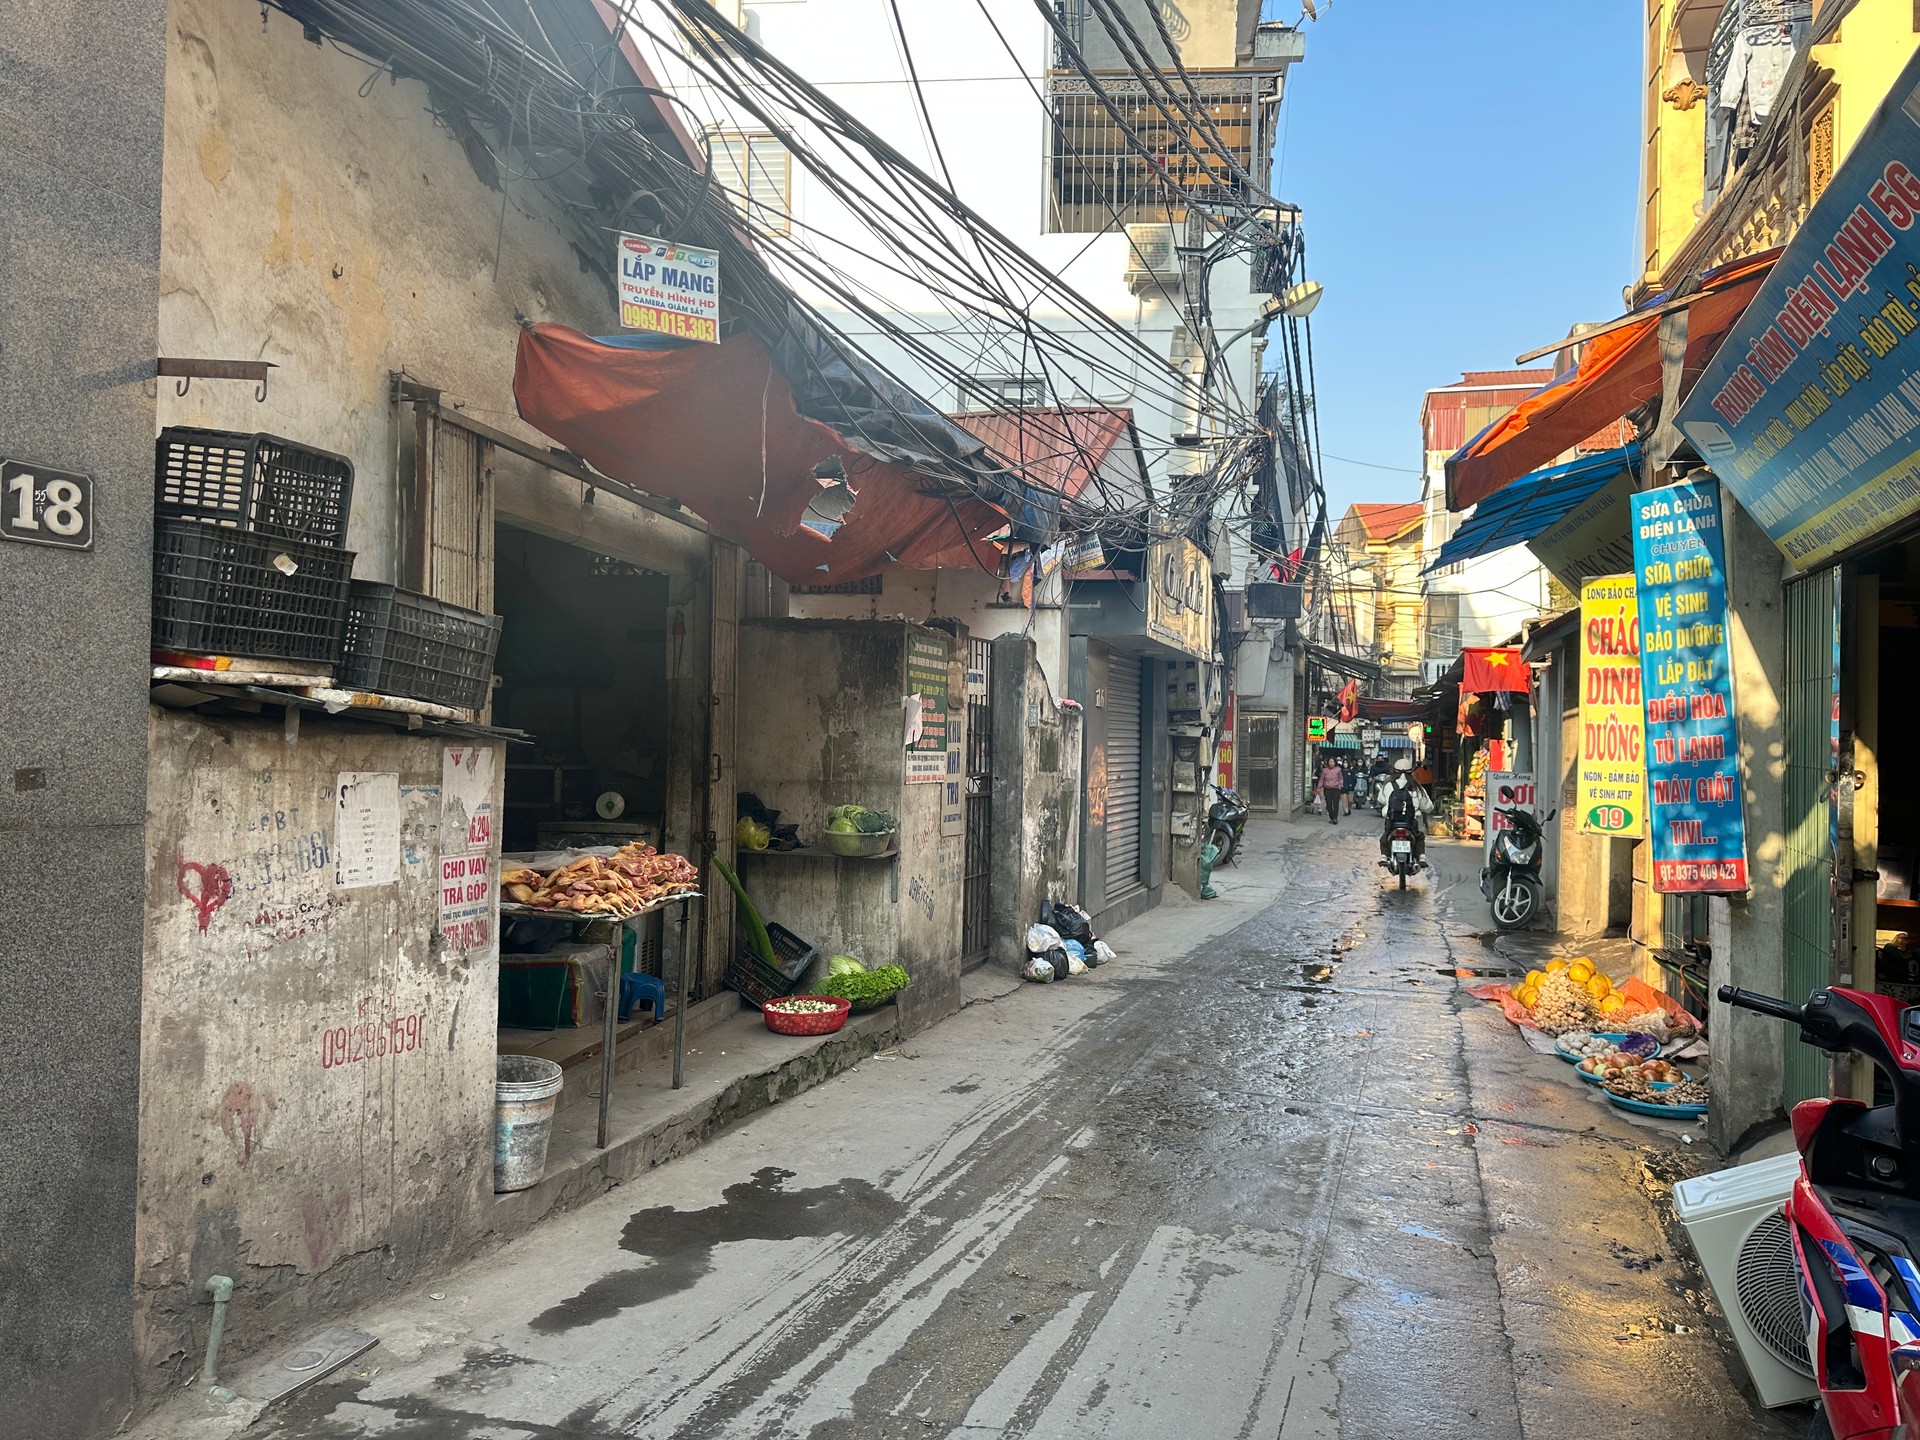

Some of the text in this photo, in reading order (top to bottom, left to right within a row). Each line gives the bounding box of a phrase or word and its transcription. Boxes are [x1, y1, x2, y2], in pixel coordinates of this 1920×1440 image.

[656, 247, 686, 261] FPT
[623, 254, 714, 294] LẮP MẠNG
[633, 295, 666, 308] CAMERA
[690, 307, 704, 316] SÁT
[699, 300, 716, 309] HD
[1711, 158, 1920, 427] TRUNG TÂM ĐIỆN LẠNH 5G
[622, 303, 715, 341] 0969.015.303
[1880, 293, 1919, 339] TRÌ
[1859, 310, 1899, 359] BẢO
[1836, 341, 1871, 382] ĐẶT
[1819, 358, 1851, 399] LẮP
[1799, 379, 1831, 418] BÁN
[1784, 398, 1815, 430] MUA
[8, 473, 84, 536] 18
[35, 489, 47, 501] 55
[1641, 495, 1713, 520] SỬA CHỮA
[1640, 514, 1716, 540] ĐIỆN LẠNH
[1652, 537, 1707, 555] CHUYÊN
[1675, 554, 1713, 582] CHỮA
[1587, 588, 1606, 600] LONG
[1608, 582, 1623, 600] BẢO
[1656, 592, 1709, 621] VỆ SINH
[1646, 621, 1724, 652] BẢO DƯỠNG
[1658, 656, 1713, 686] LẮP ĐẶT
[1586, 667, 1641, 705] DINH
[1648, 688, 1727, 723] ĐIỀU HÒA
[947, 720, 961, 743] KHU
[1584, 712, 1640, 763] DƯỠNG
[946, 746, 960, 774] NHÀ
[1654, 731, 1724, 767] TỦ LẠNH
[1584, 771, 1602, 781] NGON
[1626, 770, 1639, 784] BẢO
[1654, 771, 1734, 807] MÁY GIẶT
[946, 781, 959, 807] TRỌ
[1599, 789, 1615, 799] SINH
[1617, 790, 1633, 800] ATTP
[1597, 807, 1624, 829] 19
[1670, 819, 1718, 845] TIVI...
[443, 858, 487, 879] CHO VAY
[1676, 865, 1698, 881] 0375
[1700, 864, 1717, 880] 409
[1719, 863, 1737, 879] 423
[443, 881, 487, 905] TRẢ GÓP
[322, 1014, 423, 1069] 0912961591
